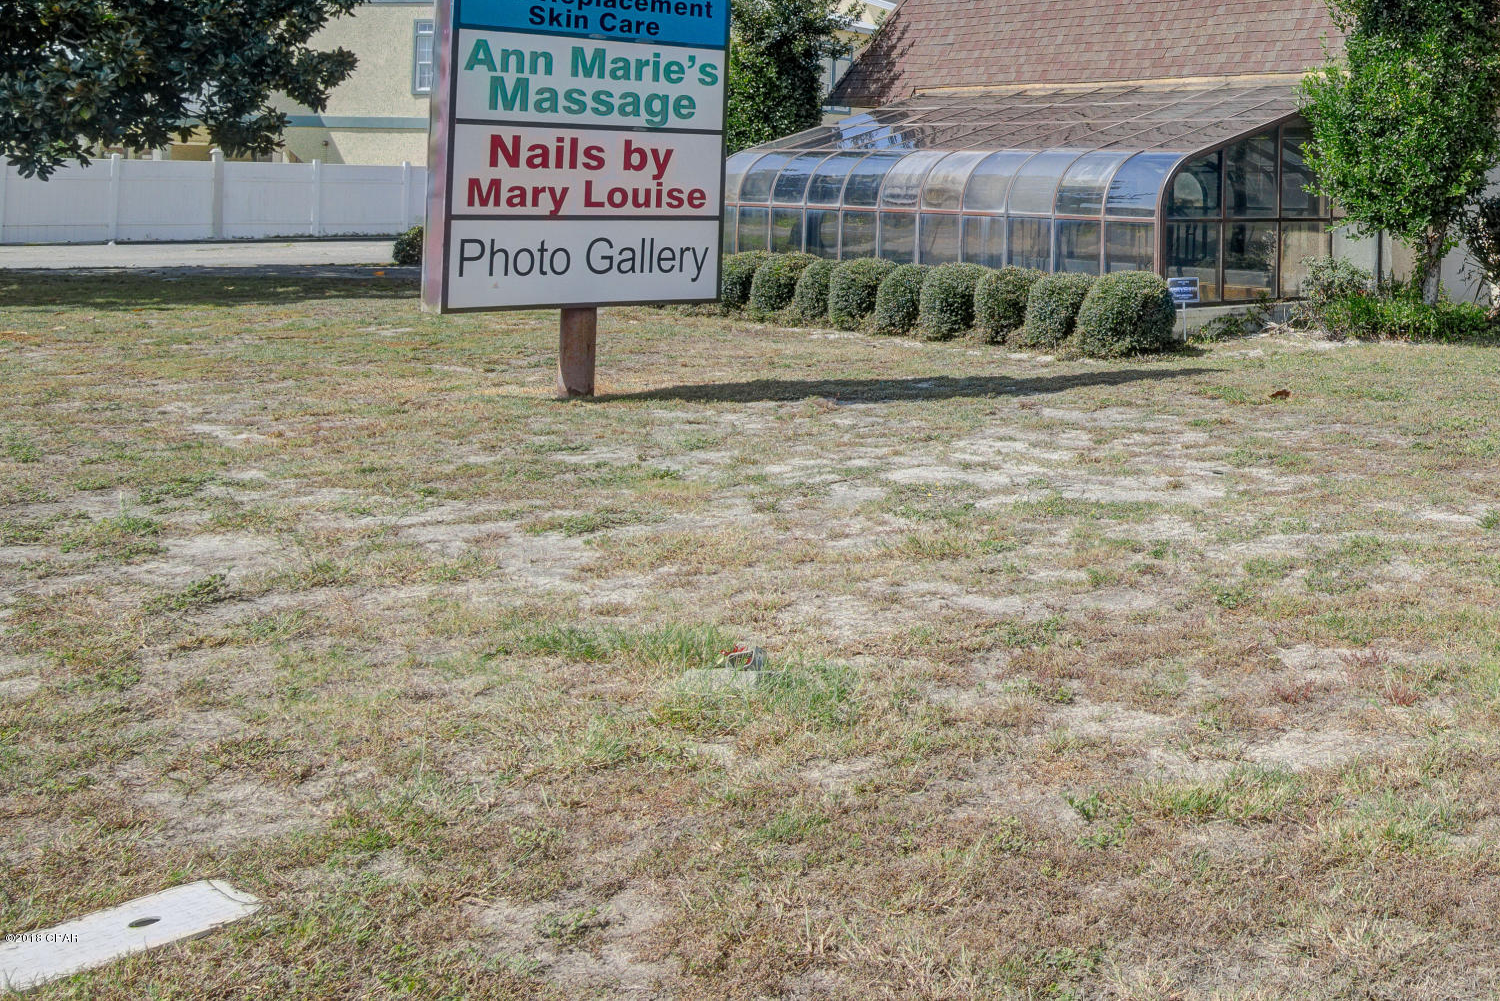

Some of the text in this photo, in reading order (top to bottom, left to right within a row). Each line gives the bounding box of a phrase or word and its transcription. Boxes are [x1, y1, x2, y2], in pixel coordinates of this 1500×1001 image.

[529, 6, 660, 36] Skin Care
[464, 39, 718, 87] Ann Marie's
[488, 76, 696, 127] Massage
[489, 134, 673, 180] Nails by
[467, 178, 706, 215] Mary Louise
[458, 237, 709, 282] Photo Gallery
